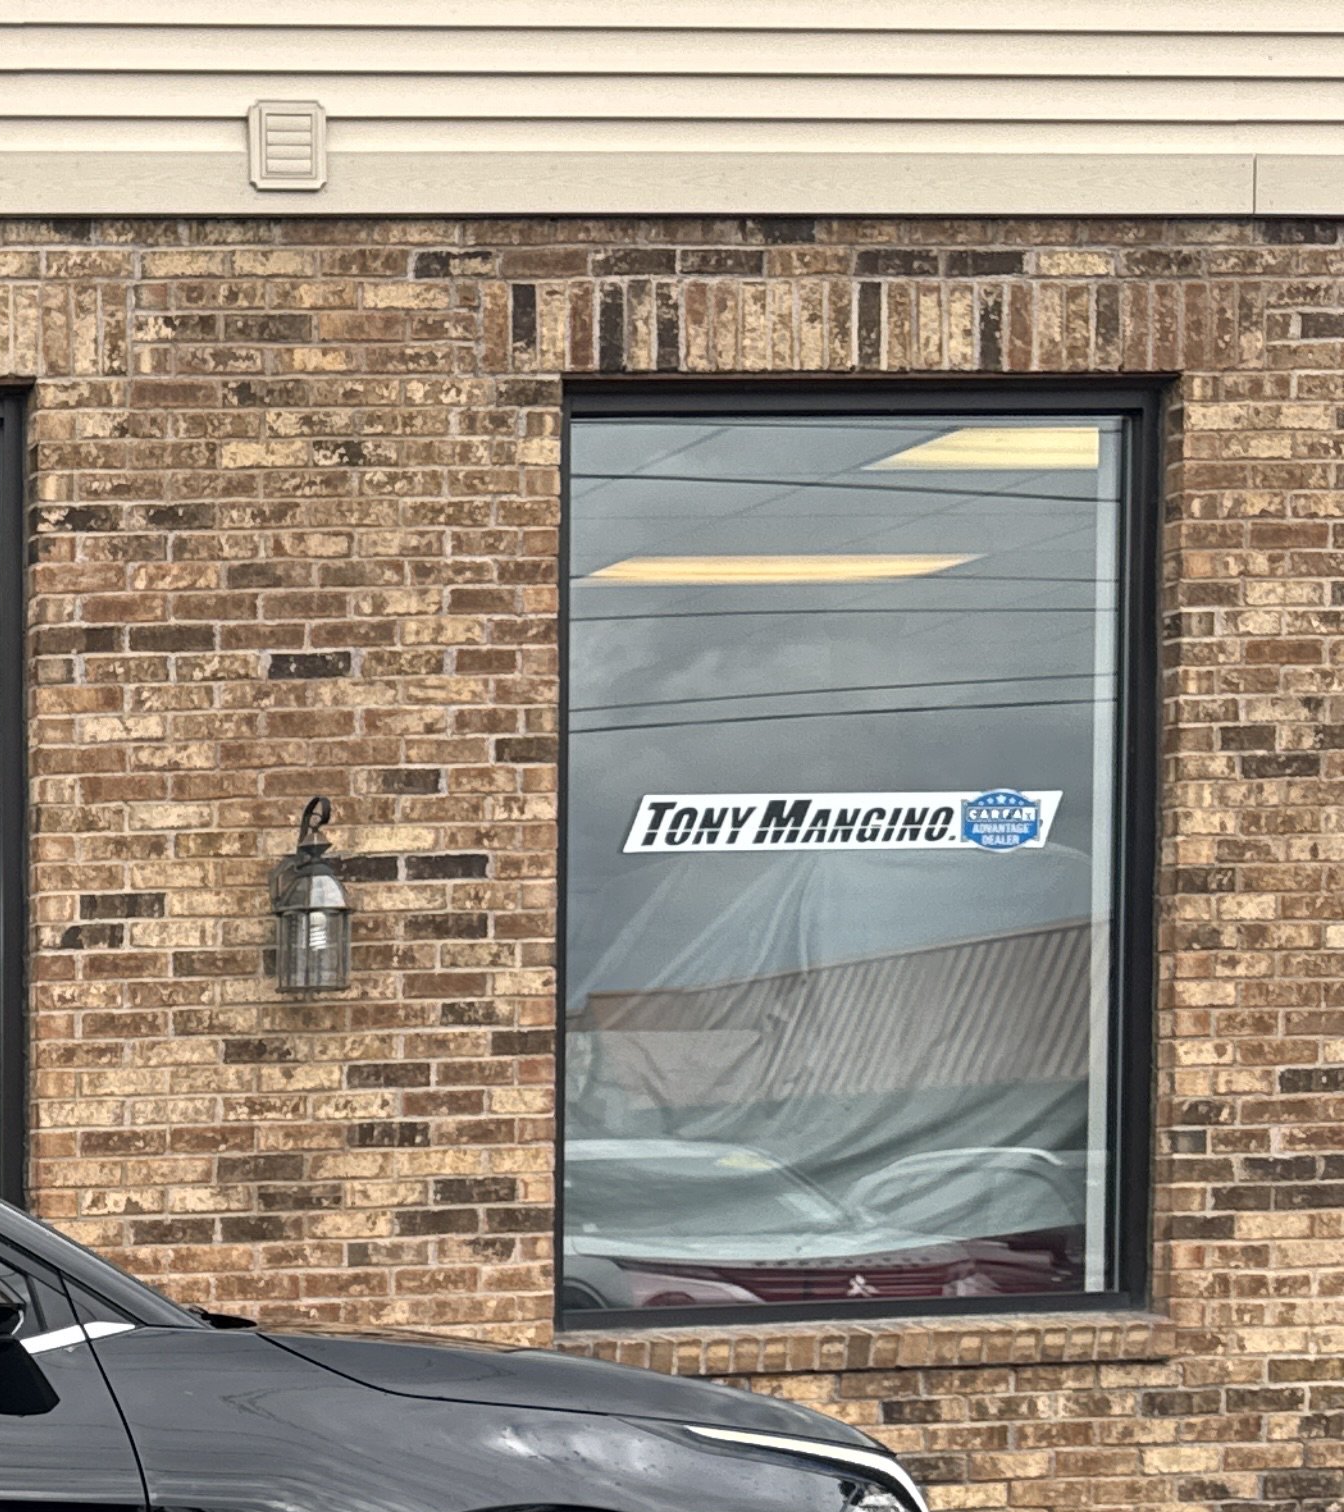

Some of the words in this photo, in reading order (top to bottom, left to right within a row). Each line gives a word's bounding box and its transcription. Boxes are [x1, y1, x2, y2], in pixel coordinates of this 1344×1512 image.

[968, 807, 1035, 821] CARFAX
[972, 822, 1030, 834] ADVANTAGE
[981, 834, 1020, 845] DEALER
